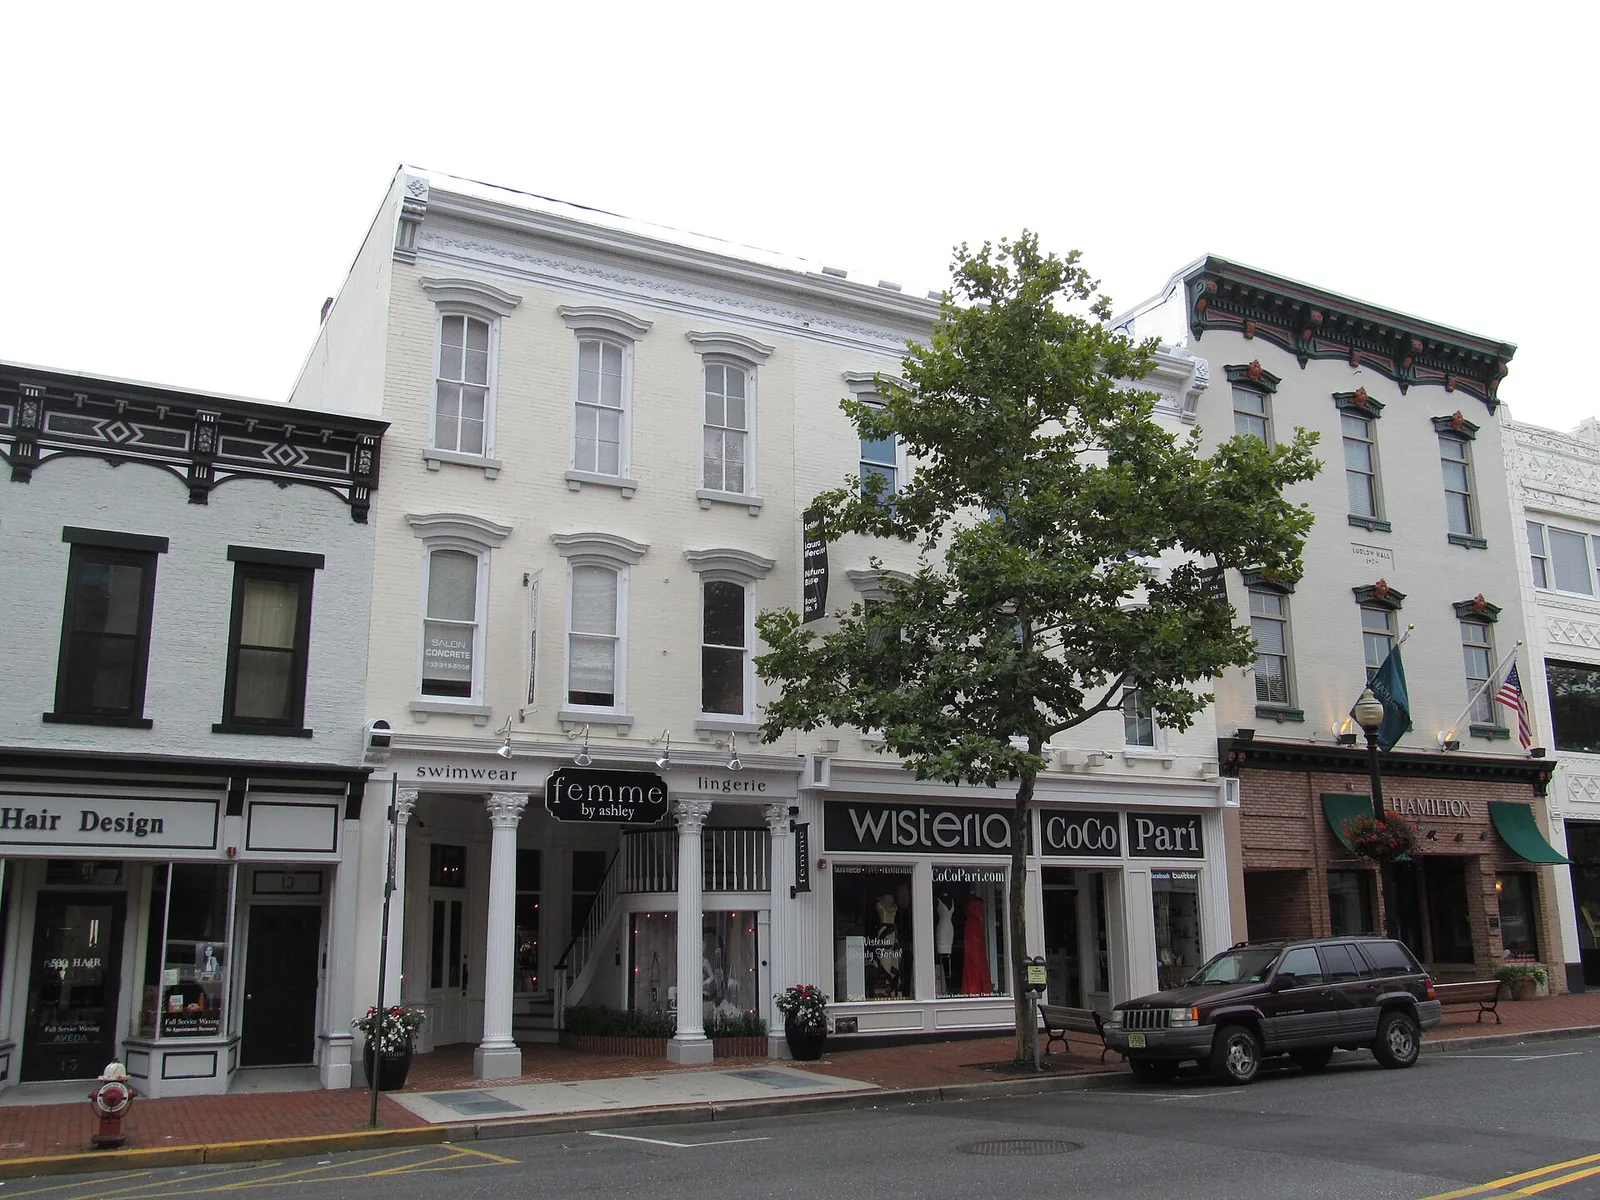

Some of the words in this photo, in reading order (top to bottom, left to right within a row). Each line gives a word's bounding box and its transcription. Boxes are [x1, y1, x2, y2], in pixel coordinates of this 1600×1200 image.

[1376, 551, 1391, 560] HALL
[431, 639, 466, 649] SALON
[425, 648, 471, 659] CONCRETE
[416, 765, 518, 782] swimwear
[552, 776, 664, 805] femme
[698, 776, 767, 793] lingerie
[581, 804, 596, 818] by
[599, 803, 635, 820] ashley
[1391, 797, 1473, 818] HAMILTON
[0, 808, 61, 831] Hair
[79, 810, 164, 838] Design
[1046, 816, 1118, 850] CoCo
[281, 876, 295, 889] 13
[931, 868, 1005, 884] CoCoPari.com
[178, 1017, 197, 1025] Service
[53, 1034, 88, 1042] AVEDA
